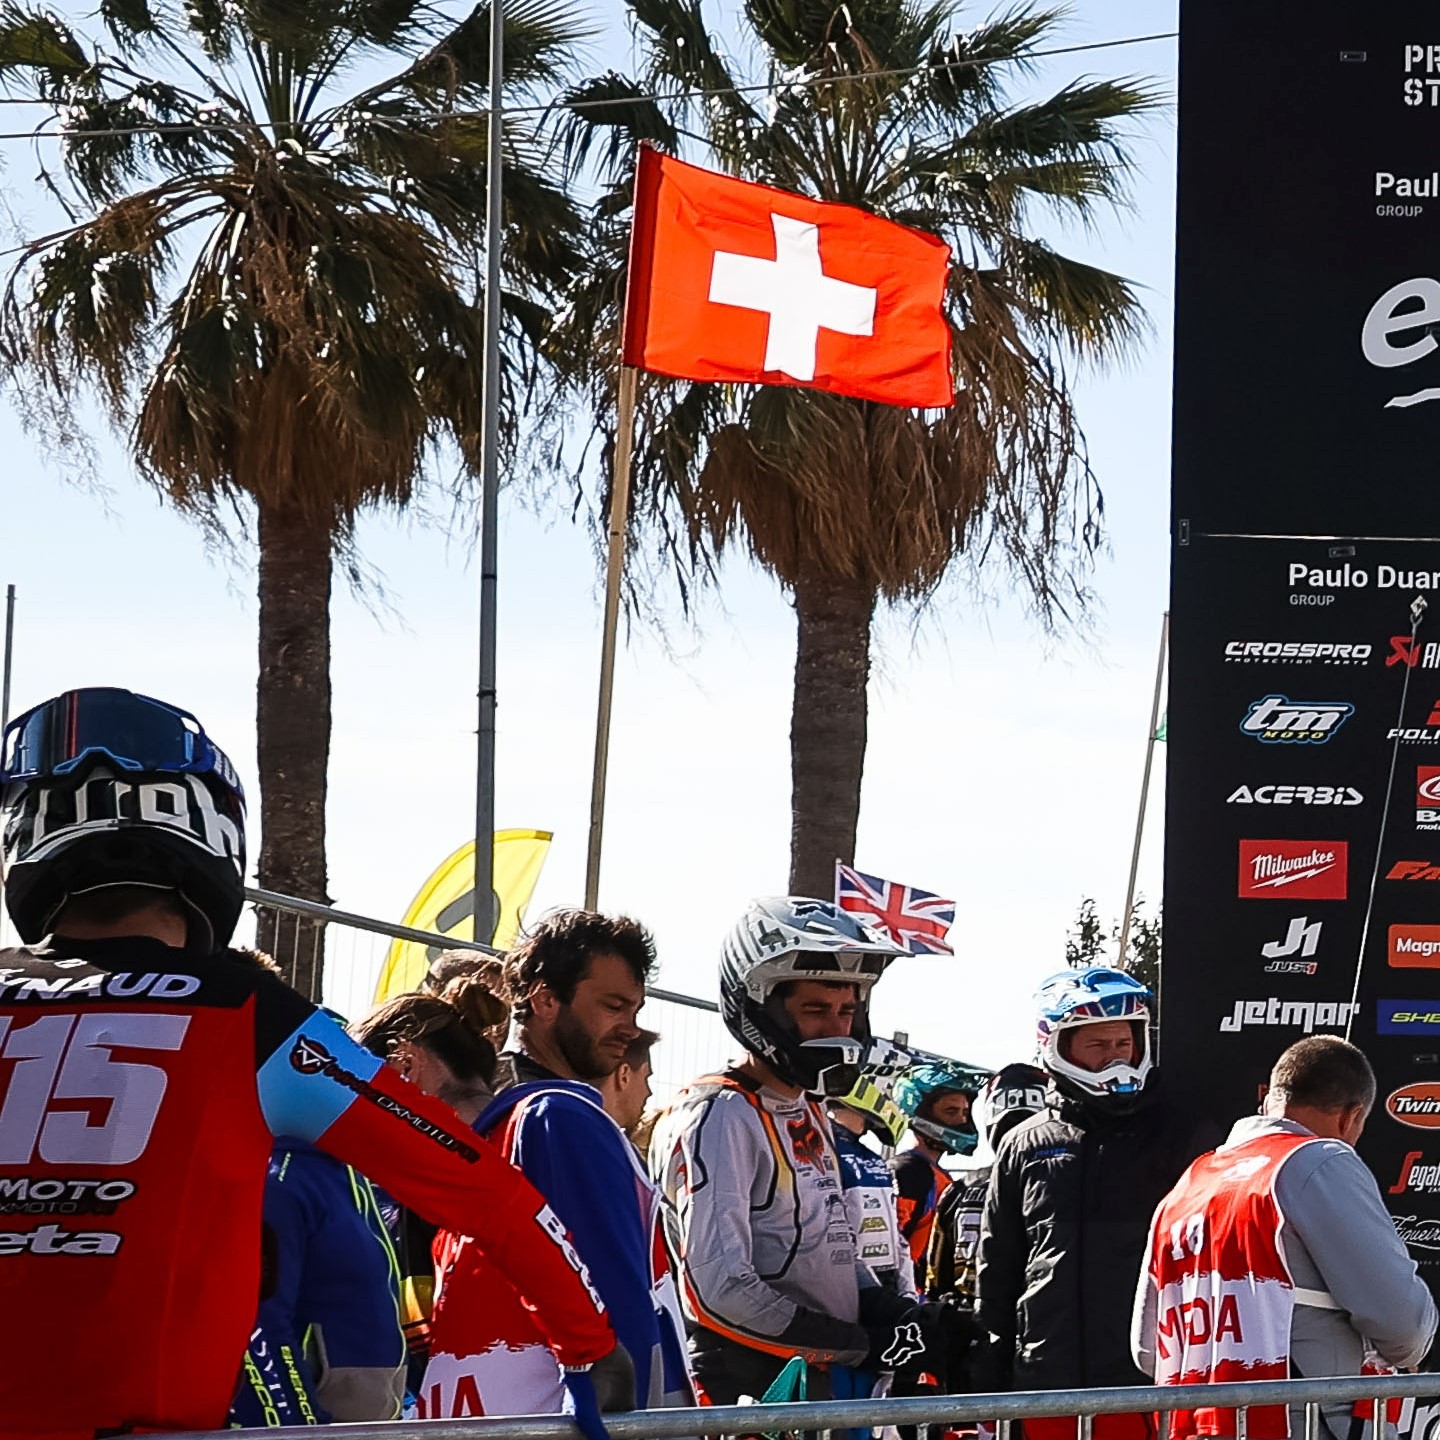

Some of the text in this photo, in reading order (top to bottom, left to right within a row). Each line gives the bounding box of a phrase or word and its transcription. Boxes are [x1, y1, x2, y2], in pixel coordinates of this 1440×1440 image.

[1376, 205, 1423, 217] GROUP
[1289, 564, 1368, 588] Paulo
[1290, 595, 1335, 606] GROUP
[1225, 641, 1371, 658] CROSSPRO
[1227, 784, 1364, 805] ACERBIS
[1250, 849, 1336, 880] Milwaukee
[0, 972, 200, 1000] YNAUD
[0, 1013, 192, 1165] 15
[1393, 1097, 1440, 1114] Twin
[0, 1179, 135, 1201] MOTO
[0, 1224, 122, 1254] eta
[535, 1203, 606, 1314] Beta
